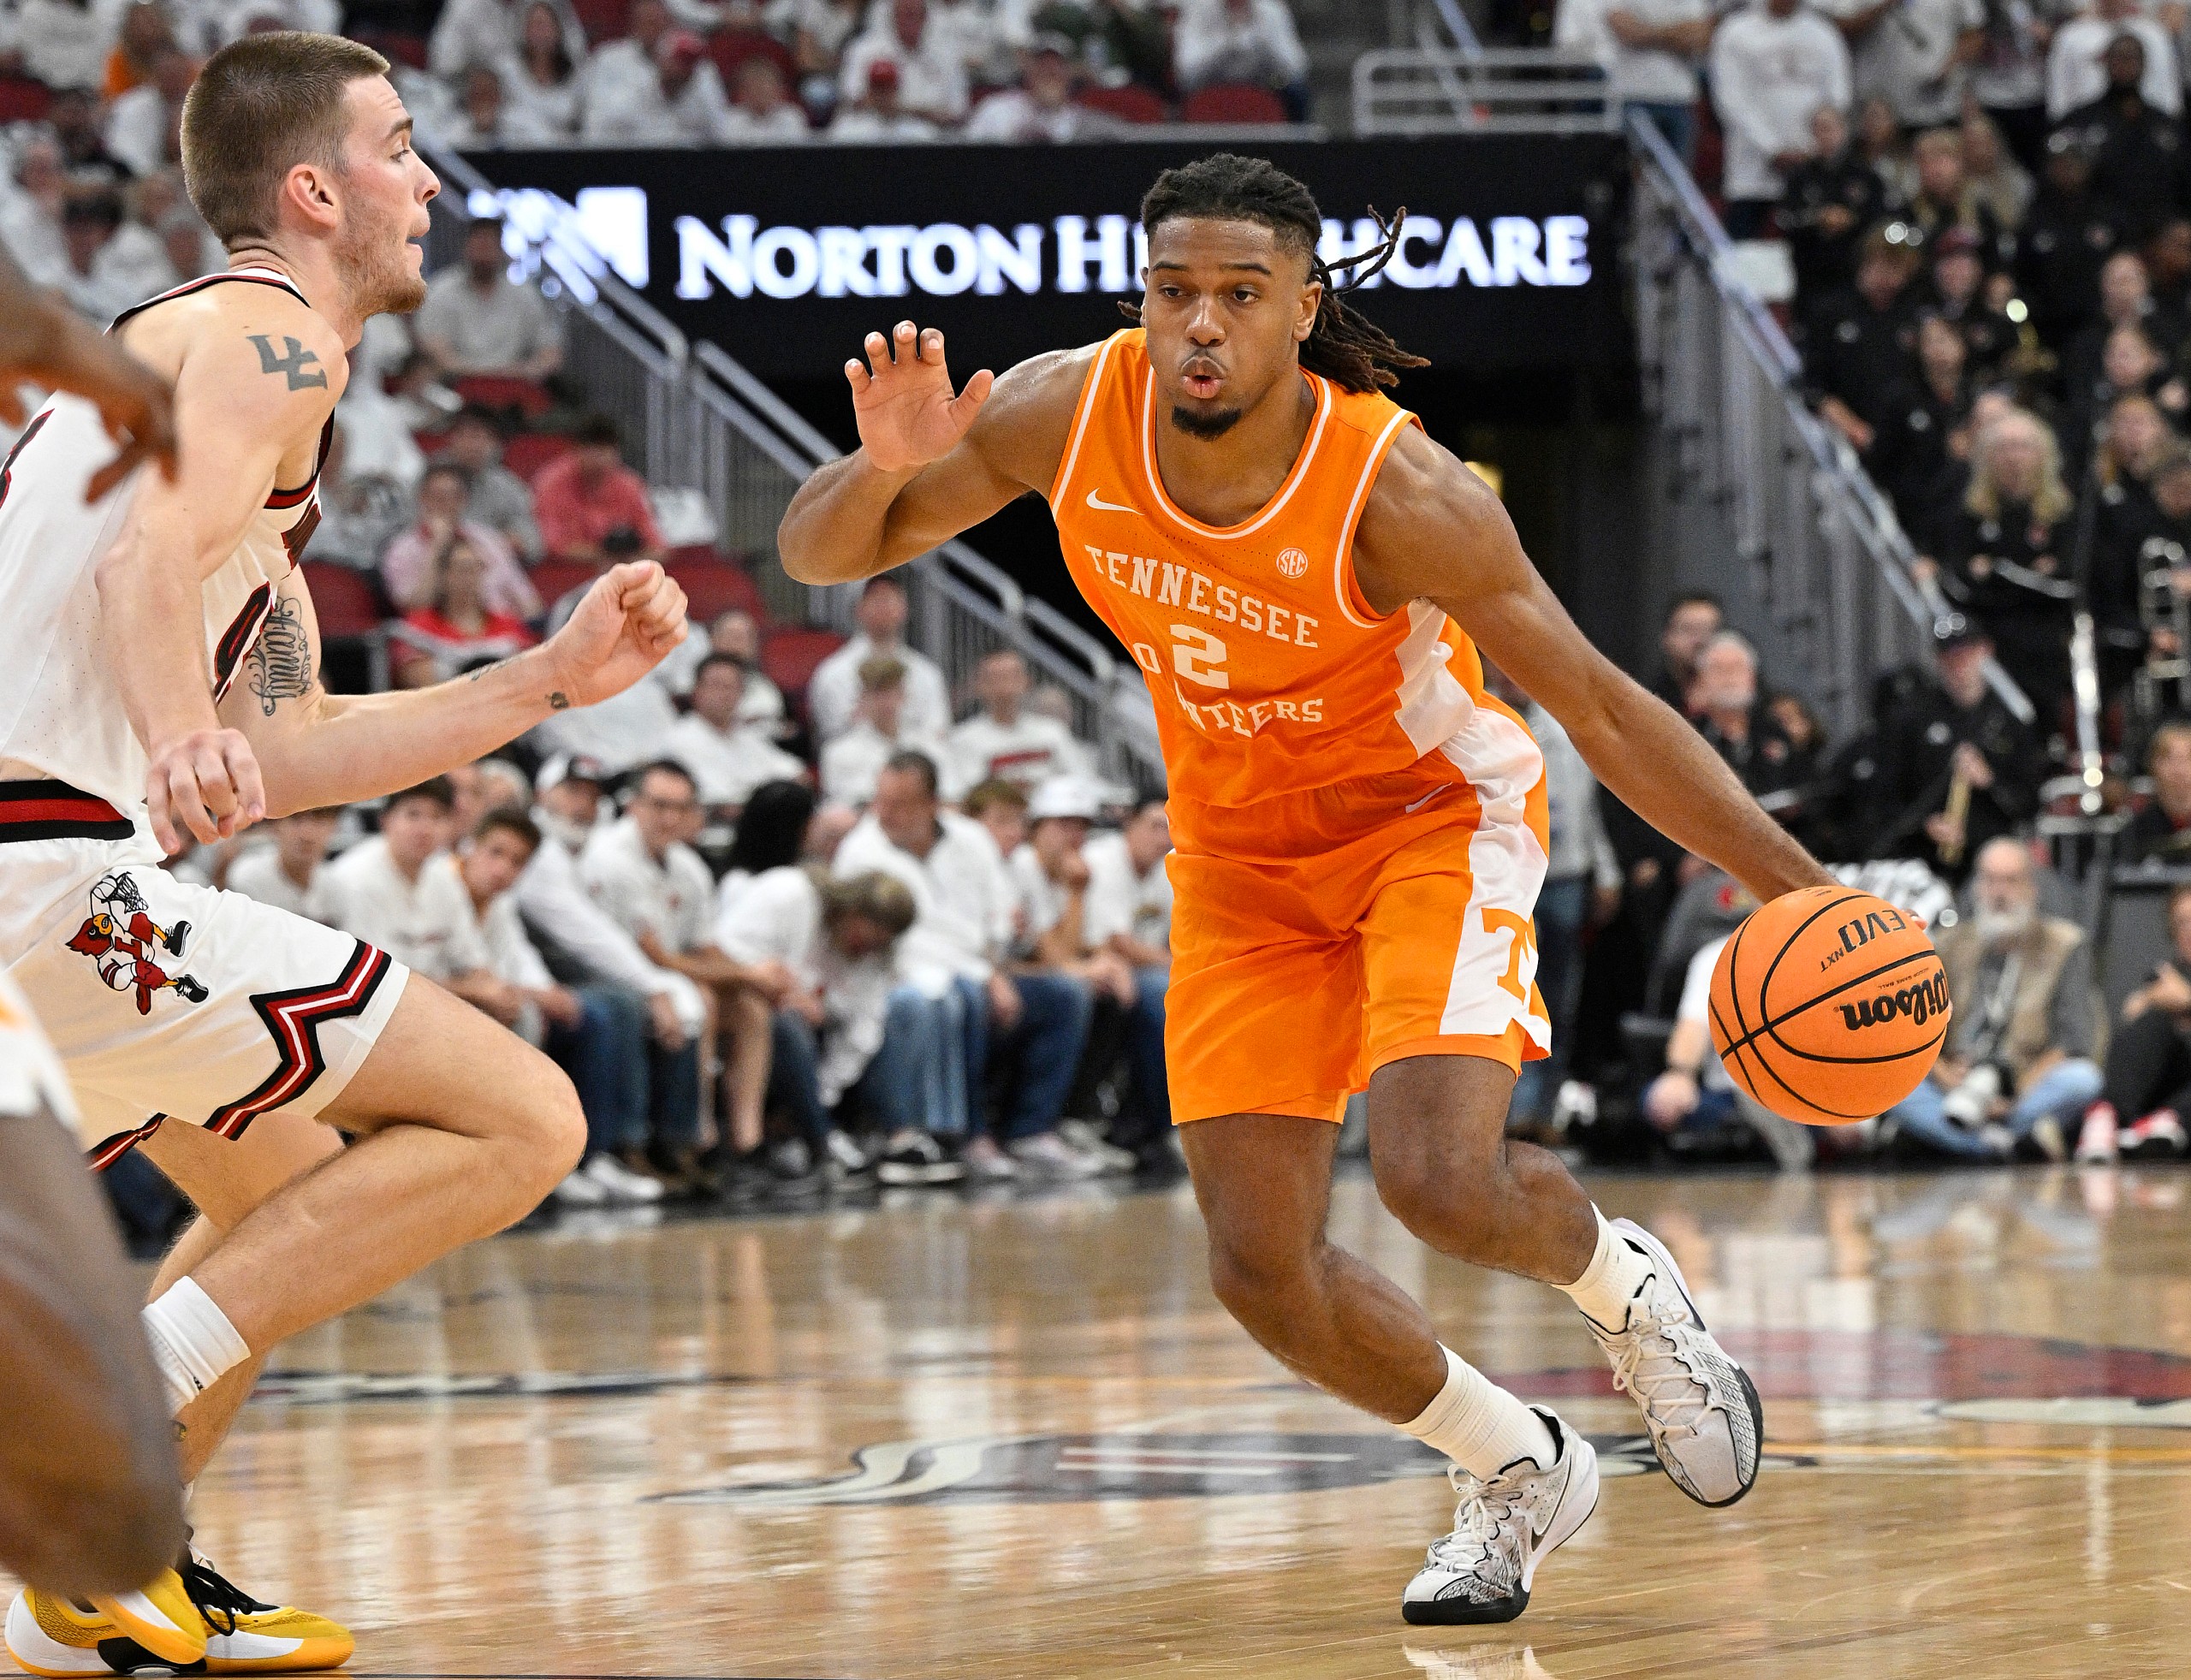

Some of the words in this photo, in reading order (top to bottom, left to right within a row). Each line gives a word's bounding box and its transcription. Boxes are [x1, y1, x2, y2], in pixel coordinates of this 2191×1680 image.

[674, 214, 1045, 300] NORTON
[1054, 214, 1591, 293] HHCARE
[1279, 549, 1306, 576] SEC
[1084, 544, 1319, 648] TENNESSEE
[1169, 624, 1230, 690] 2
[1820, 947, 1844, 973] NXT
[1840, 968, 1950, 1031] Wilson
